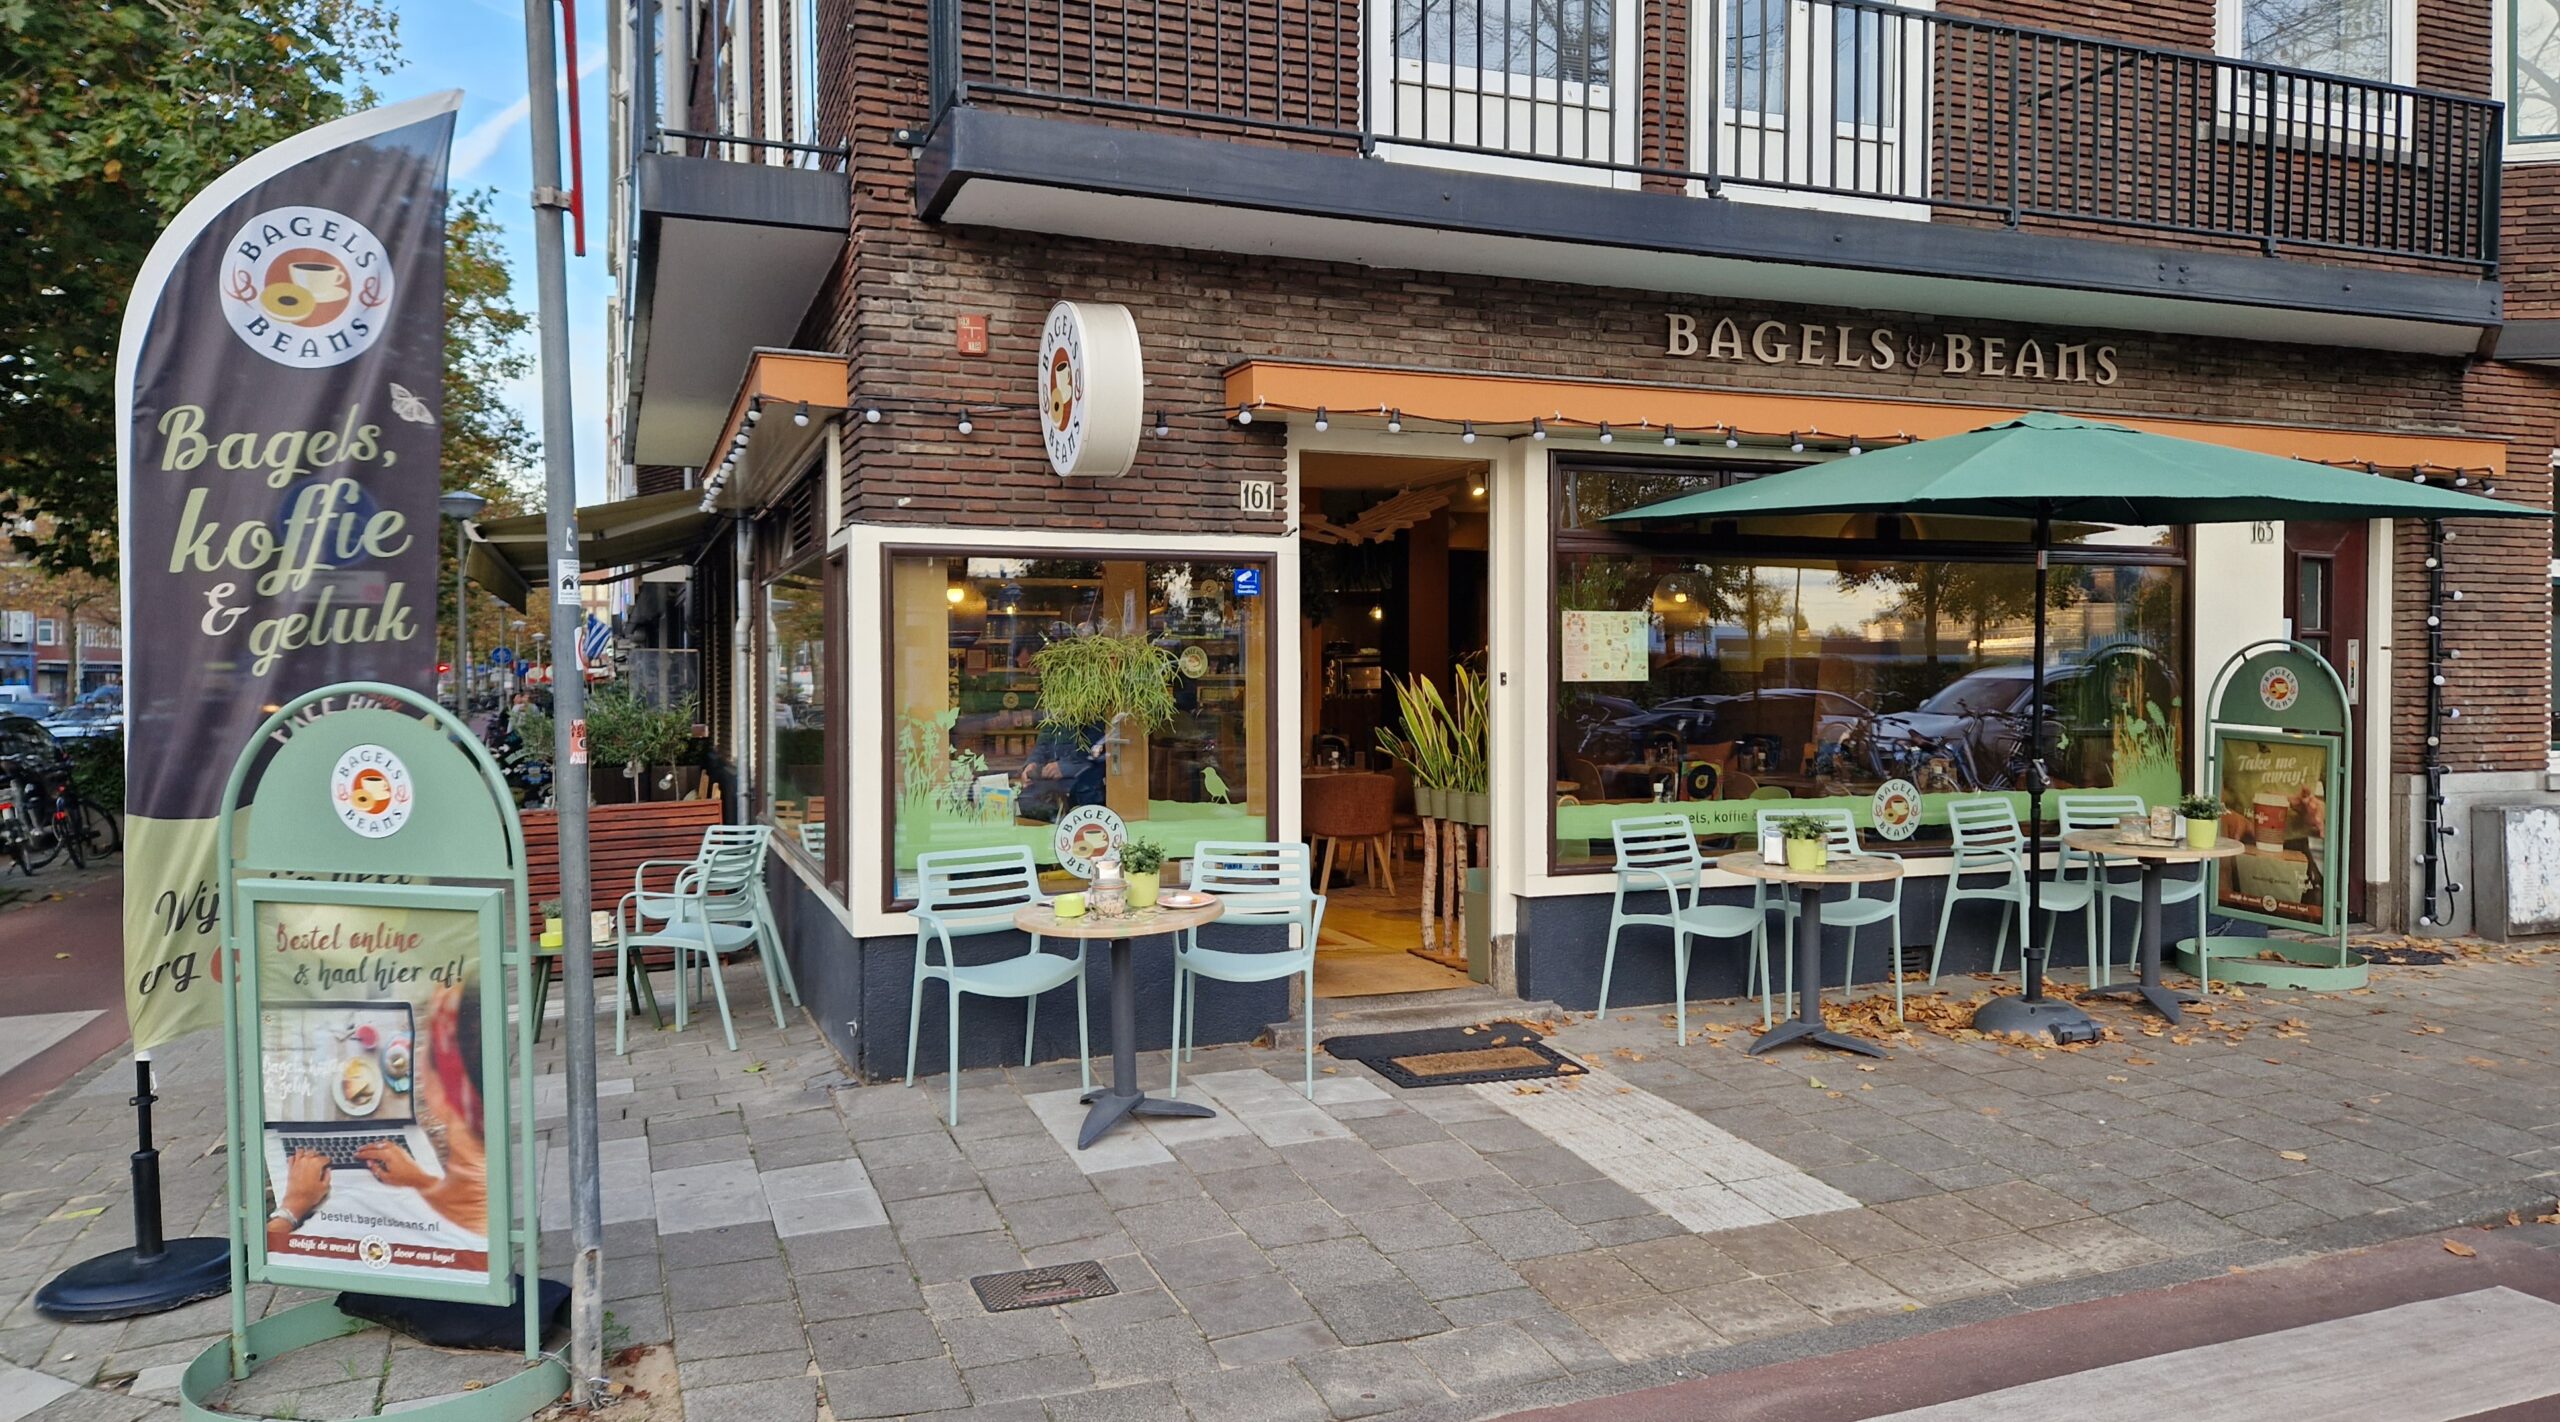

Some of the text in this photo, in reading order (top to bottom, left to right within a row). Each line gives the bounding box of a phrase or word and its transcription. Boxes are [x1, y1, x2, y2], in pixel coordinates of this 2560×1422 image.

[237, 216, 377, 268] BAGELS
[245, 316, 369, 358] BEANS
[1042, 314, 1079, 372] BAGELS
[1664, 312, 1895, 370] BAGELS
[1943, 333, 2119, 386] BEANS
[157, 403, 397, 488] Bagels,
[1048, 415, 1081, 464] BEANS
[1243, 483, 1273, 510] 161
[168, 478, 414, 597] koffie
[2252, 520, 2274, 542] 163
[201, 582, 419, 677] & geluk
[339, 749, 403, 781] BAGELS
[2238, 753, 2297, 771] Take me
[2261, 766, 2309, 787] away!
[1878, 782, 1917, 802] BAGELS
[345, 808, 403, 833] BEANS
[1063, 809, 1120, 833] BAGELS
[1714, 810, 1748, 823] koffie
[1879, 820, 1915, 837] BEANS
[276, 922, 423, 953] Bestel online
[139, 951, 201, 996] erg
[318, 954, 367, 991] haal
[374, 954, 424, 991] hier
[430, 954, 465, 989] af!
[320, 1210, 441, 1232] bestel.bagelsbeans.nl
